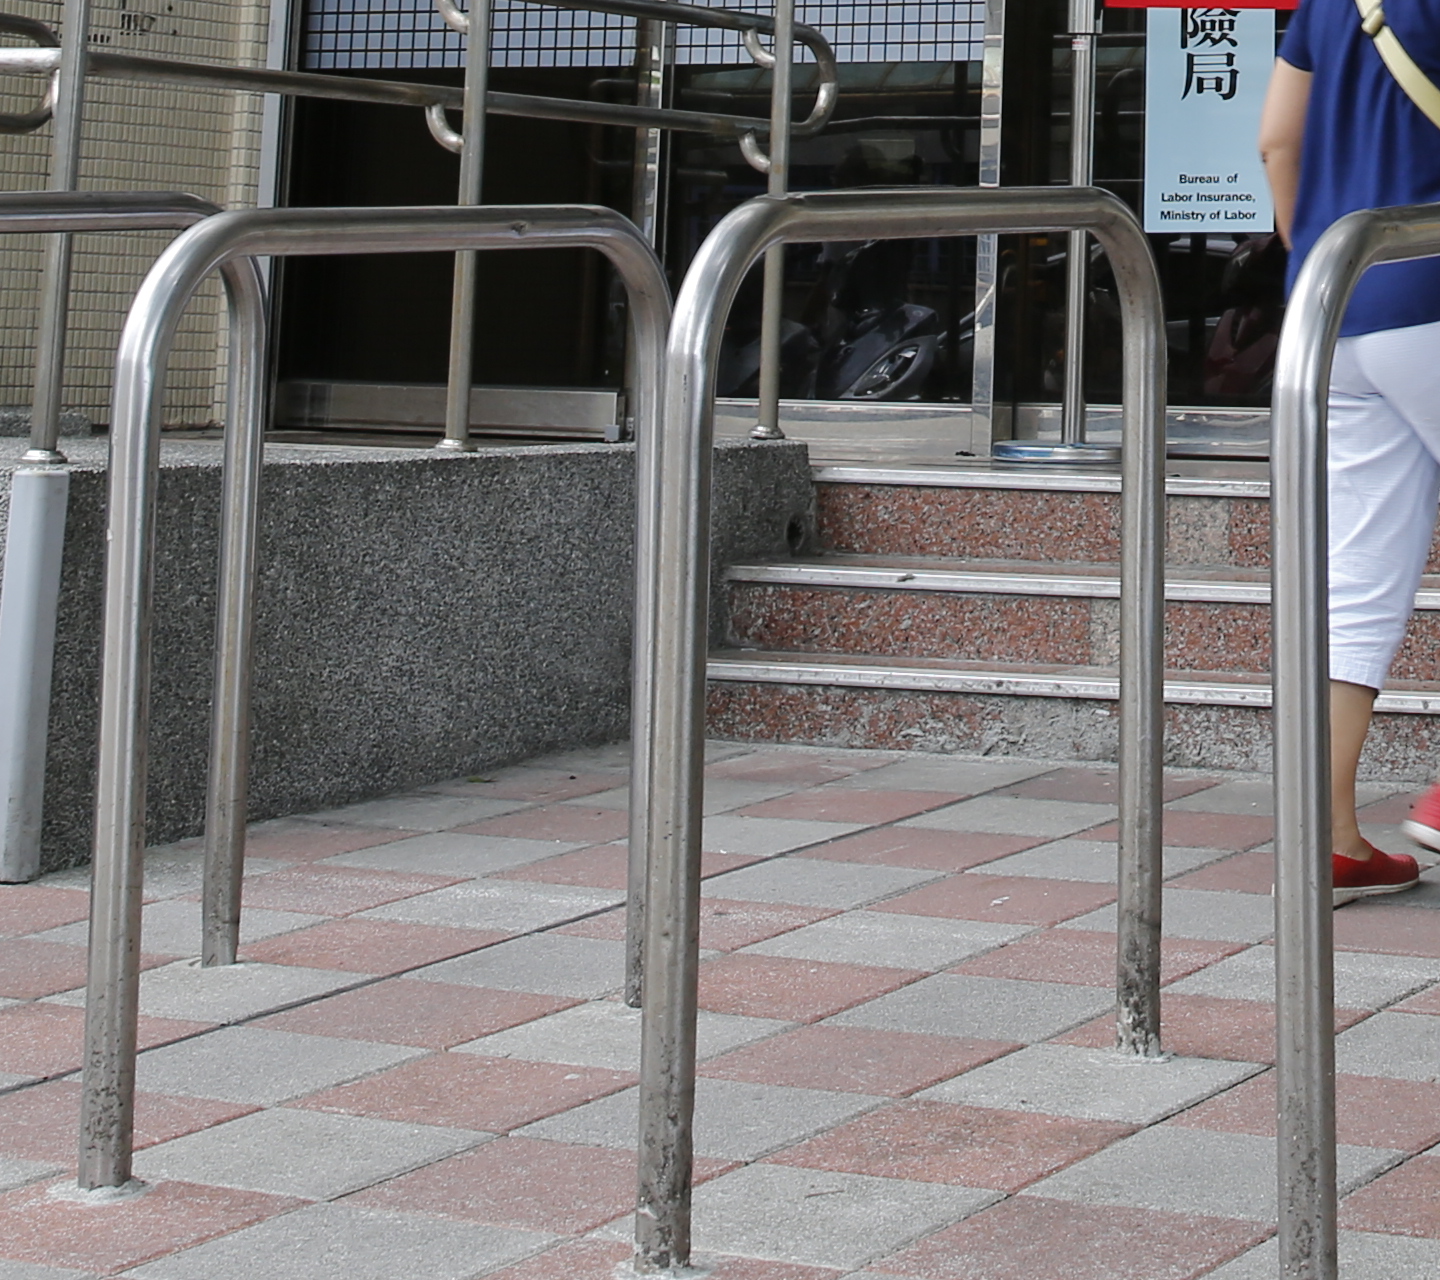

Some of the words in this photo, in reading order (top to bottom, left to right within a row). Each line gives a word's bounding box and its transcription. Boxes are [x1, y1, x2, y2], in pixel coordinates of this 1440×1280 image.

[1178, 173, 1220, 184] Bureau
[1226, 173, 1238, 184] of
[1161, 192, 1193, 202] Labor
[1196, 192, 1256, 203] Insurance,
[1160, 210, 1206, 222] Ministry
[1209, 210, 1220, 220] of
[1224, 210, 1257, 220] Labor
